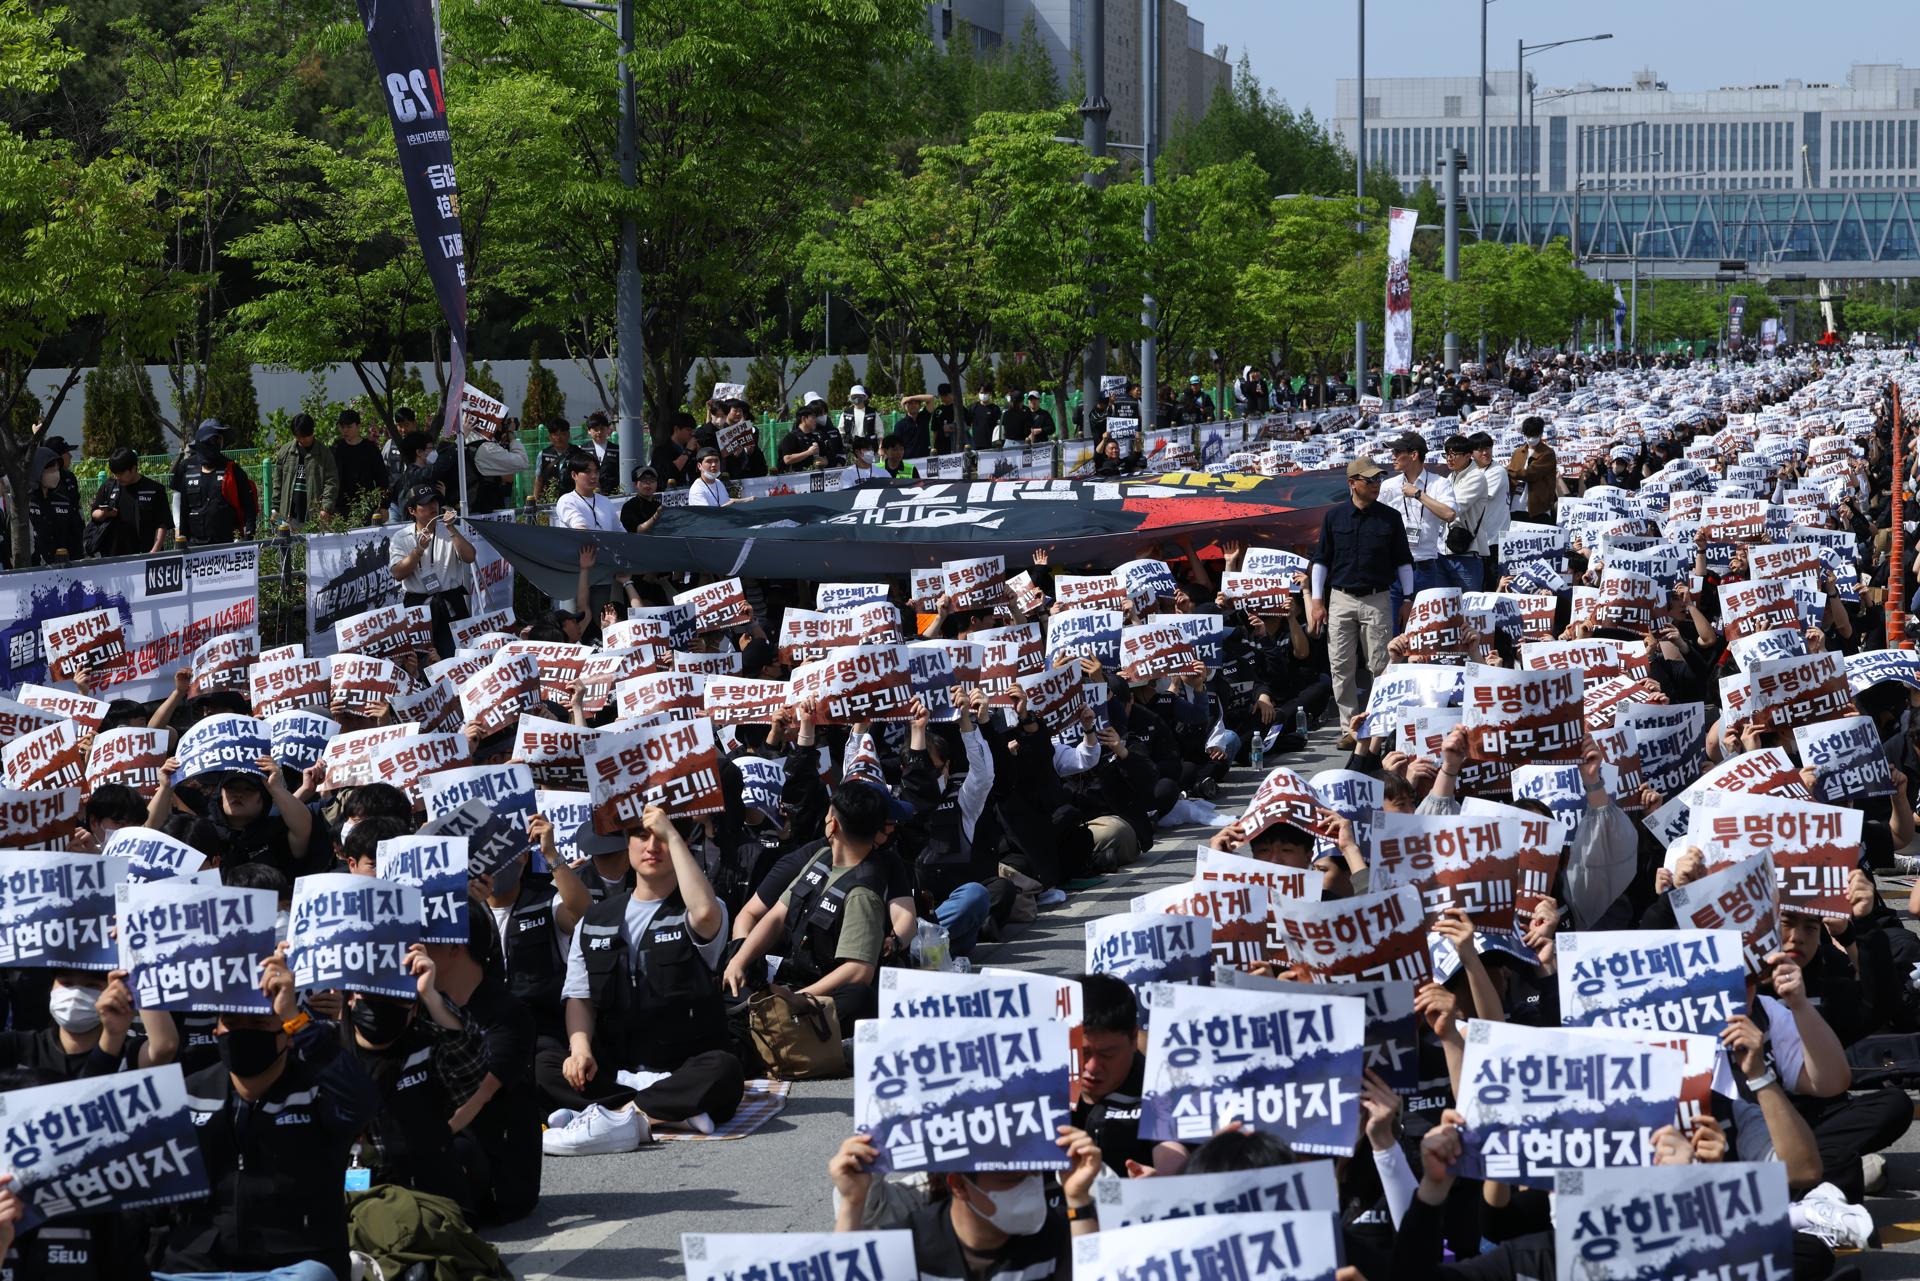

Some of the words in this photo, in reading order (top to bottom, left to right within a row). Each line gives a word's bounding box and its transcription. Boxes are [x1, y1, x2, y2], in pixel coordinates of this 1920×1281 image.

[1706, 501, 1761, 521] 투명하게
[1503, 536, 1556, 557] 상한폐지
[1711, 523, 1763, 540] 바꾸고!!!
[148, 566, 181, 591] NSEU
[185, 551, 256, 580] 전국삼성전자노동조합
[949, 559, 1000, 585] 투명하게
[1754, 545, 1812, 570] 투명하게
[692, 581, 735, 607] 명하게
[821, 584, 880, 603] 상한폐지
[916, 575, 943, 591] 투명
[957, 583, 1004, 608] 바꾸고!!!
[1061, 576, 1119, 597] 투명하게
[1226, 577, 1286, 593] 투명하게
[1726, 580, 1786, 613] 투명하게
[1794, 588, 1817, 604] 폐지
[1410, 595, 1461, 625] 투명하게
[1519, 596, 1549, 611] 하게
[1574, 597, 1599, 614] 투명
[49, 611, 111, 651] 투명하게
[341, 607, 397, 643] 투명하게
[409, 630, 431, 646] 고!!!
[457, 610, 509, 644] 투명하게
[786, 618, 853, 639] 투명하게
[1050, 612, 1112, 644] 상한폐지
[1124, 624, 1182, 655] 투명하게
[1523, 618, 1551, 633] 고!!!
[195, 636, 254, 670] 투명하게
[262, 646, 295, 662] 하게
[506, 645, 582, 659] 투명하게
[823, 648, 902, 685] 투명하게
[910, 650, 946, 677] 폐지
[1018, 652, 1046, 674] 고!!!
[1136, 650, 1195, 678] 바꾸고!!!
[1530, 646, 1608, 672] 투명하게
[199, 665, 251, 692] 바꾸고
[254, 660, 321, 696] 투명하게
[332, 660, 383, 681] 명하게
[467, 656, 533, 706] 투명하게
[540, 666, 577, 683] 고!!!
[979, 677, 1012, 697] 고!!!
[1025, 665, 1075, 705] 명하게
[1758, 655, 1838, 697] 투명하게
[624, 676, 694, 711] 투명하게
[711, 682, 784, 701] 투명하게
[829, 684, 913, 718] 바꾸고!!!
[1472, 672, 1573, 715] 투명하게
[1771, 688, 1852, 726] 바꾸고!!!
[272, 716, 327, 740] 한폐지
[714, 702, 781, 722] 바꾸고!!!
[7, 726, 65, 781] 투명하게
[92, 728, 156, 767] 투명하게
[180, 718, 260, 756] 상한폐지
[331, 725, 407, 759] 투명하게
[595, 722, 700, 786] 투명하게
[1483, 719, 1583, 756] 바꾸고!!!
[1638, 722, 1694, 767] 한폐지
[1807, 722, 1879, 766] 상한폐지
[377, 735, 460, 780] 투명하게
[740, 762, 782, 783] 폐지
[1460, 760, 1514, 789] 꾸고!!!
[1647, 747, 1705, 796] 현하자
[1714, 751, 1783, 793] 명하게
[615, 767, 718, 821] 바꾸고!!!
[1318, 778, 1374, 806] 폐지
[1823, 756, 1893, 801] 실현하자
[1240, 799, 1326, 837] 바꾸고
[1711, 811, 1844, 850] 투명하게
[1379, 821, 1503, 874] 투명하게
[1774, 866, 1850, 899] 고!!!
[125, 893, 255, 951] 상한폐지
[294, 887, 403, 936] 상한폐지
[519, 917, 546, 932] SELU
[1283, 893, 1406, 957] 투명하게
[0, 914, 116, 963] 실현하자
[588, 937, 612, 950] 투쟁
[654, 930, 682, 943] SELU
[1090, 920, 1196, 975] 상한폐지
[293, 940, 408, 990] 실현하자
[1211, 940, 1261, 973] 고!!!
[1570, 934, 1721, 997] 상한폐지
[136, 952, 266, 1008] 실현하자
[1161, 1003, 1335, 1071] 상한폐지
[396, 1070, 428, 1091] SELU
[869, 1026, 1043, 1101] 상한폐지
[1471, 1050, 1651, 1106] 상한폐지
[4, 1075, 162, 1169] 상한폐지
[275, 1112, 312, 1126] SELU
[1171, 1077, 1363, 1140] 실현하자
[1408, 1097, 1447, 1113] SELU
[885, 1095, 1072, 1171] 실현하자
[1480, 1125, 1656, 1179] 실현하자
[33, 1138, 200, 1218] 실현하자
[1571, 1170, 1764, 1263] 상한폐지
[48, 1250, 88, 1264] SELU
[1095, 1220, 1302, 1281] 한폐지
